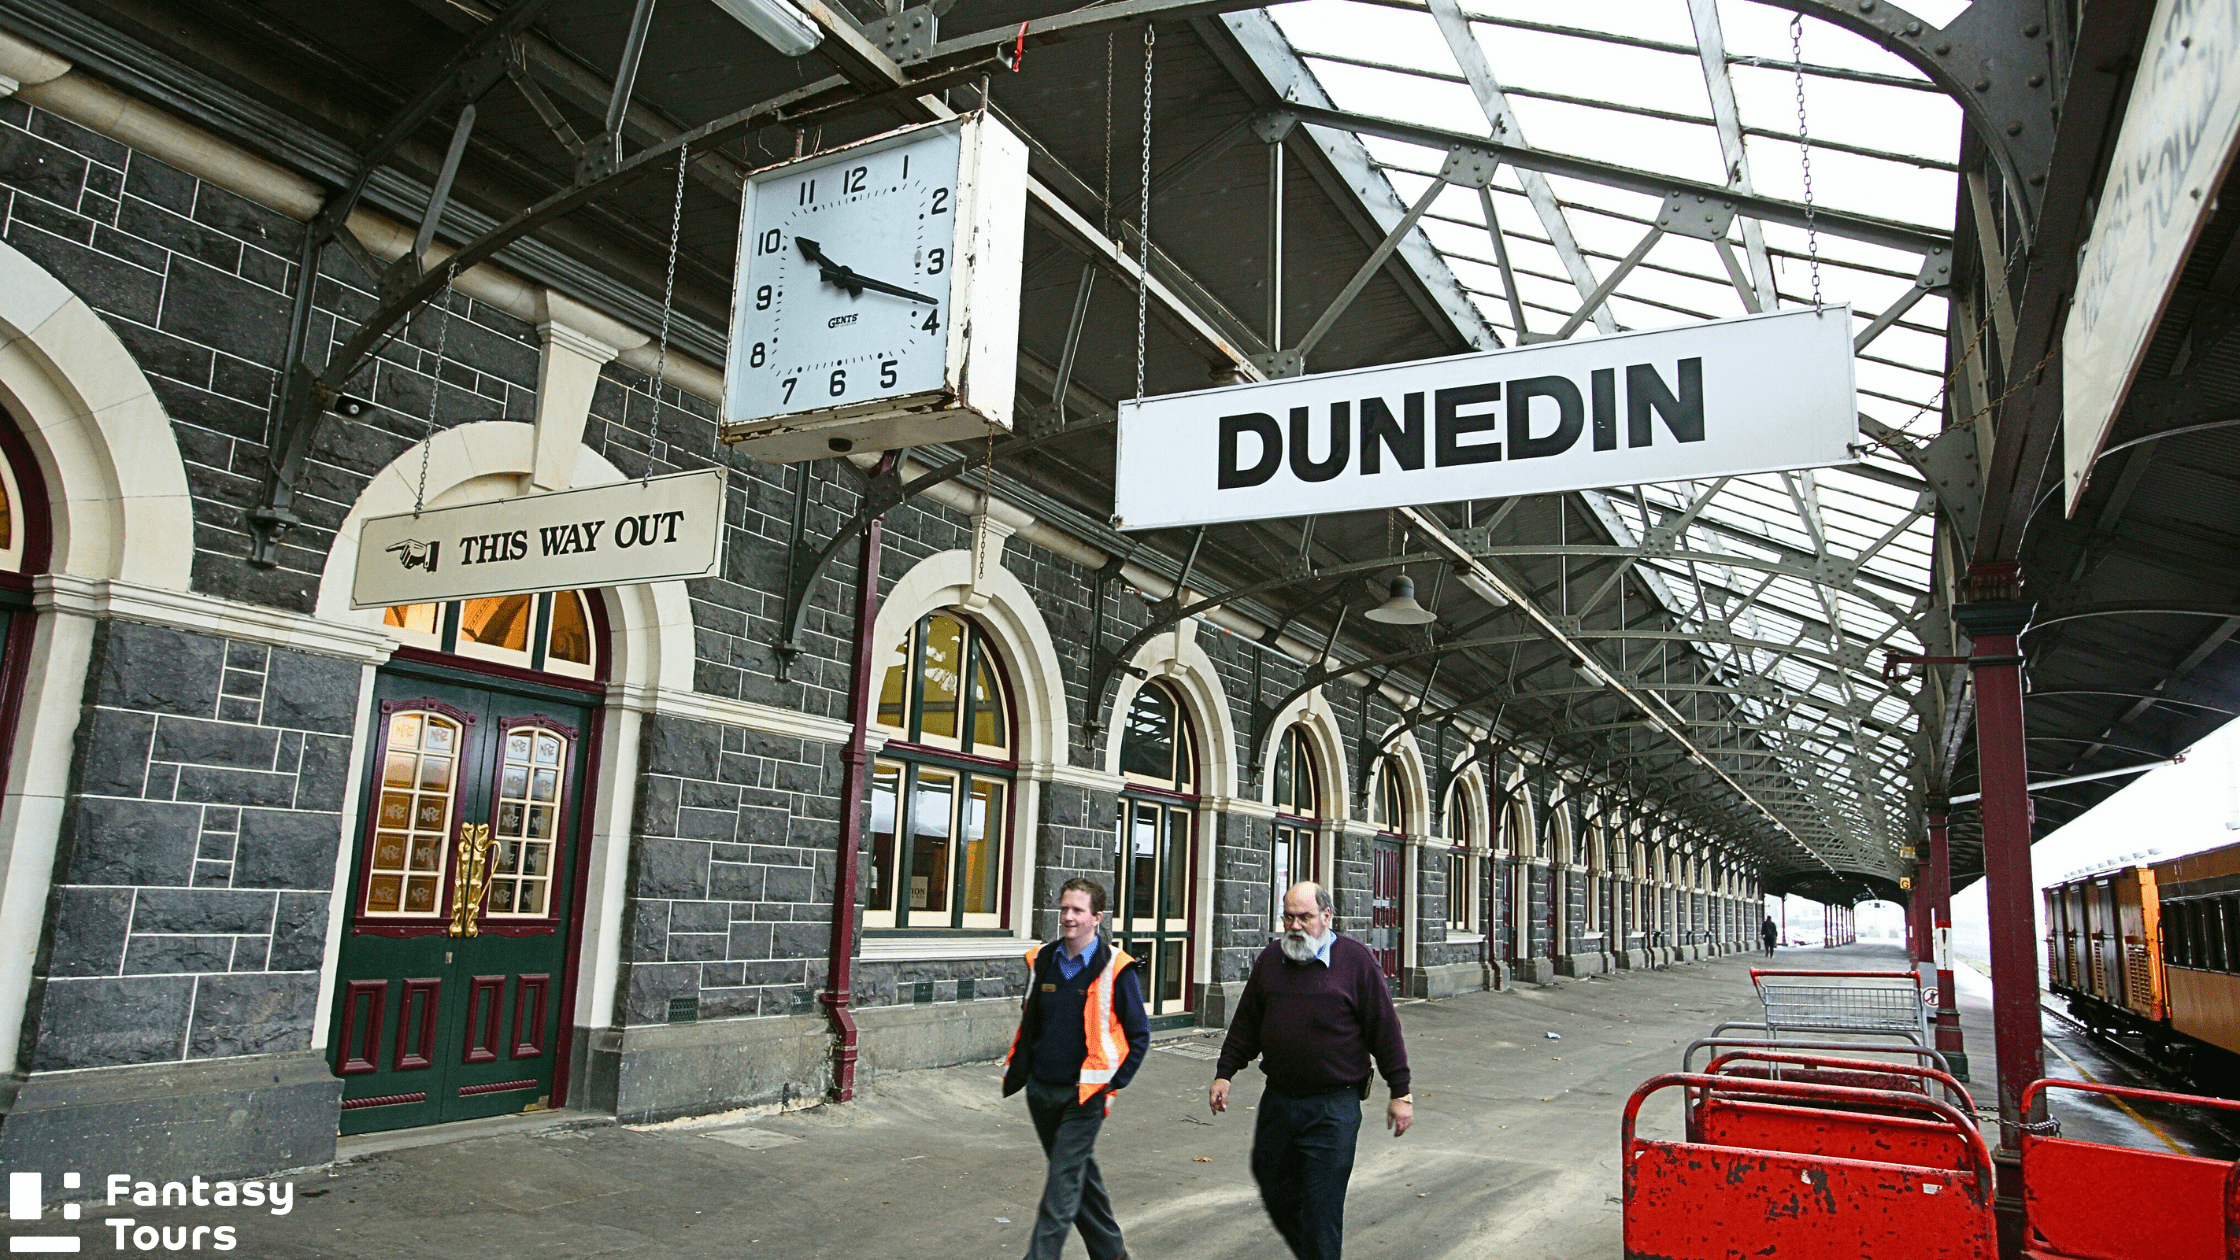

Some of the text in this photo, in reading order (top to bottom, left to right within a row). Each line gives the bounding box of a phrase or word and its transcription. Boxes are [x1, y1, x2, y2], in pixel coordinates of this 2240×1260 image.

[843, 166, 867, 194] 12
[903, 155, 908, 180] 1
[800, 179, 815, 206] 11
[931, 187, 949, 215] 2
[758, 228, 781, 256] 10
[927, 248, 944, 275] 3
[757, 285, 772, 311] 9
[922, 309, 940, 336] 4
[750, 342, 766, 368] 8
[829, 369, 846, 396] 6
[880, 360, 898, 388] 5
[782, 378, 797, 405] 7
[1218, 356, 1706, 491] DUNEDIN
[460, 511, 685, 566] THIS WAY OUT
